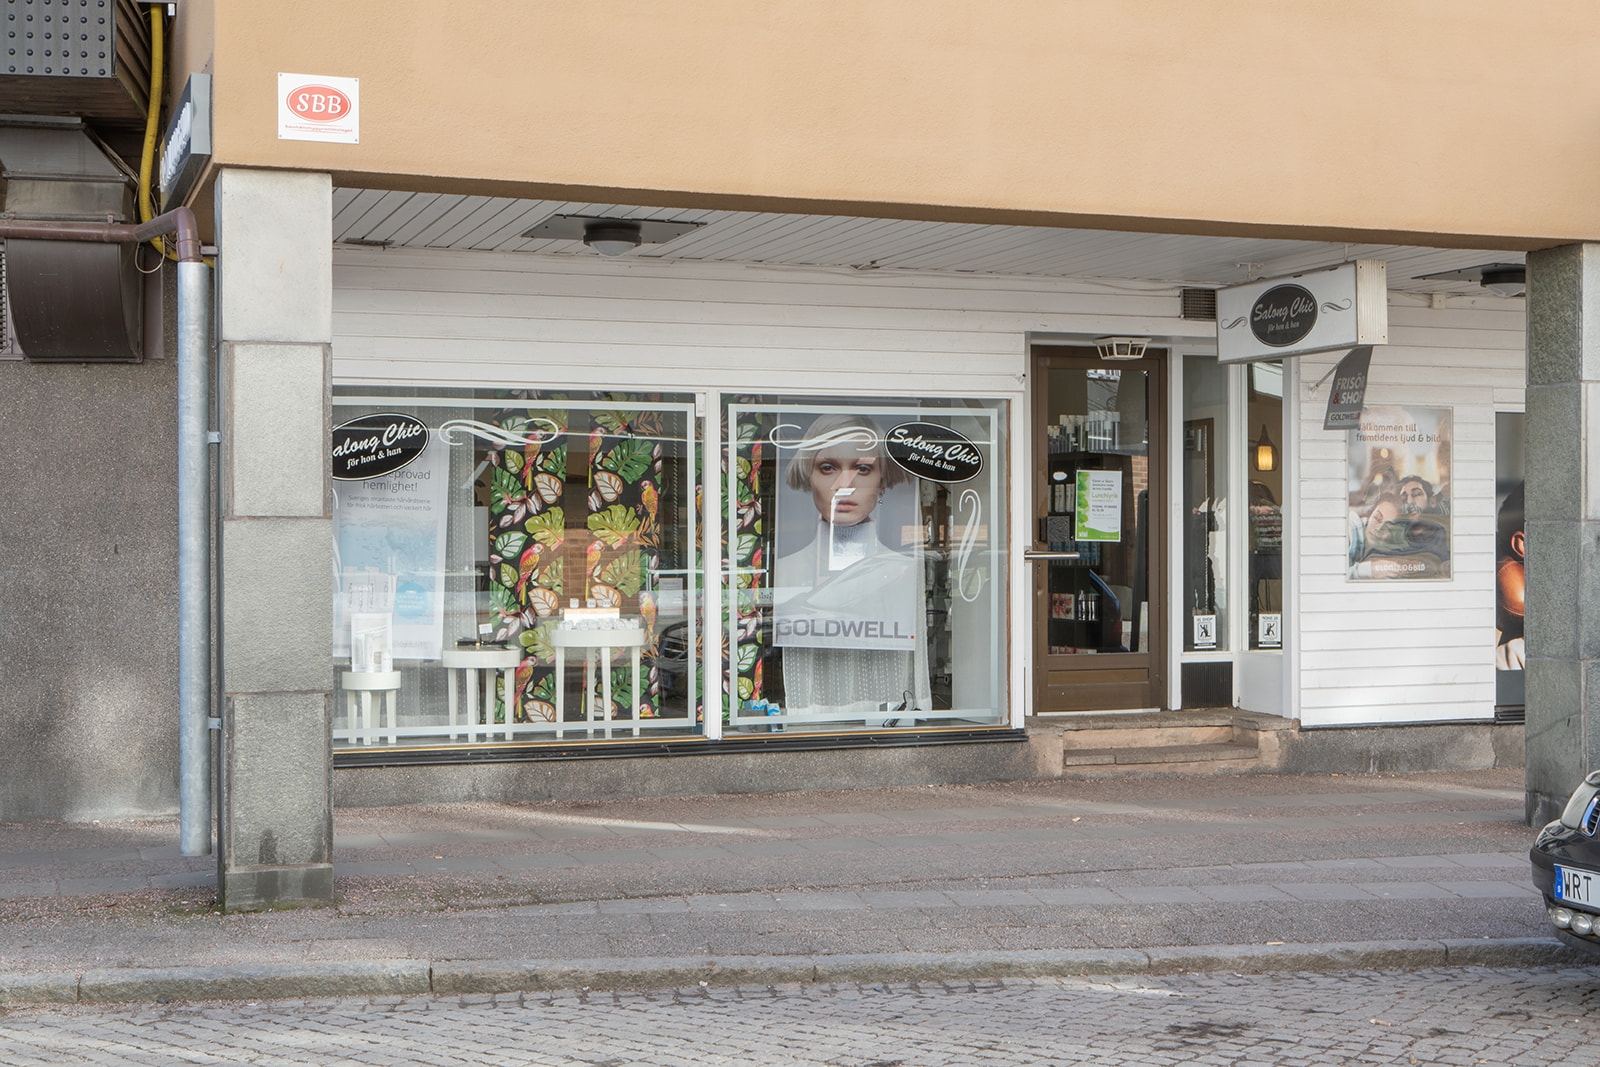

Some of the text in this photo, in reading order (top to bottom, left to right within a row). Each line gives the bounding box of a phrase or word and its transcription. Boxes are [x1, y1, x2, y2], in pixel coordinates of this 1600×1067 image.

[296, 93, 342, 114] SBB
[1254, 297, 1314, 322] Salong Chic
[1332, 392, 1340, 405] &
[333, 422, 423, 457] along Chic
[890, 429, 980, 464] Salong Chic
[1356, 433, 1399, 442] framtidens
[1400, 433, 1416, 444] ljud
[1417, 434, 1424, 442] &
[346, 447, 402, 470] för hon & han
[908, 453, 957, 472] för hon & han
[362, 480, 418, 493] hemlighet!
[1563, 871, 1592, 902] WRT
